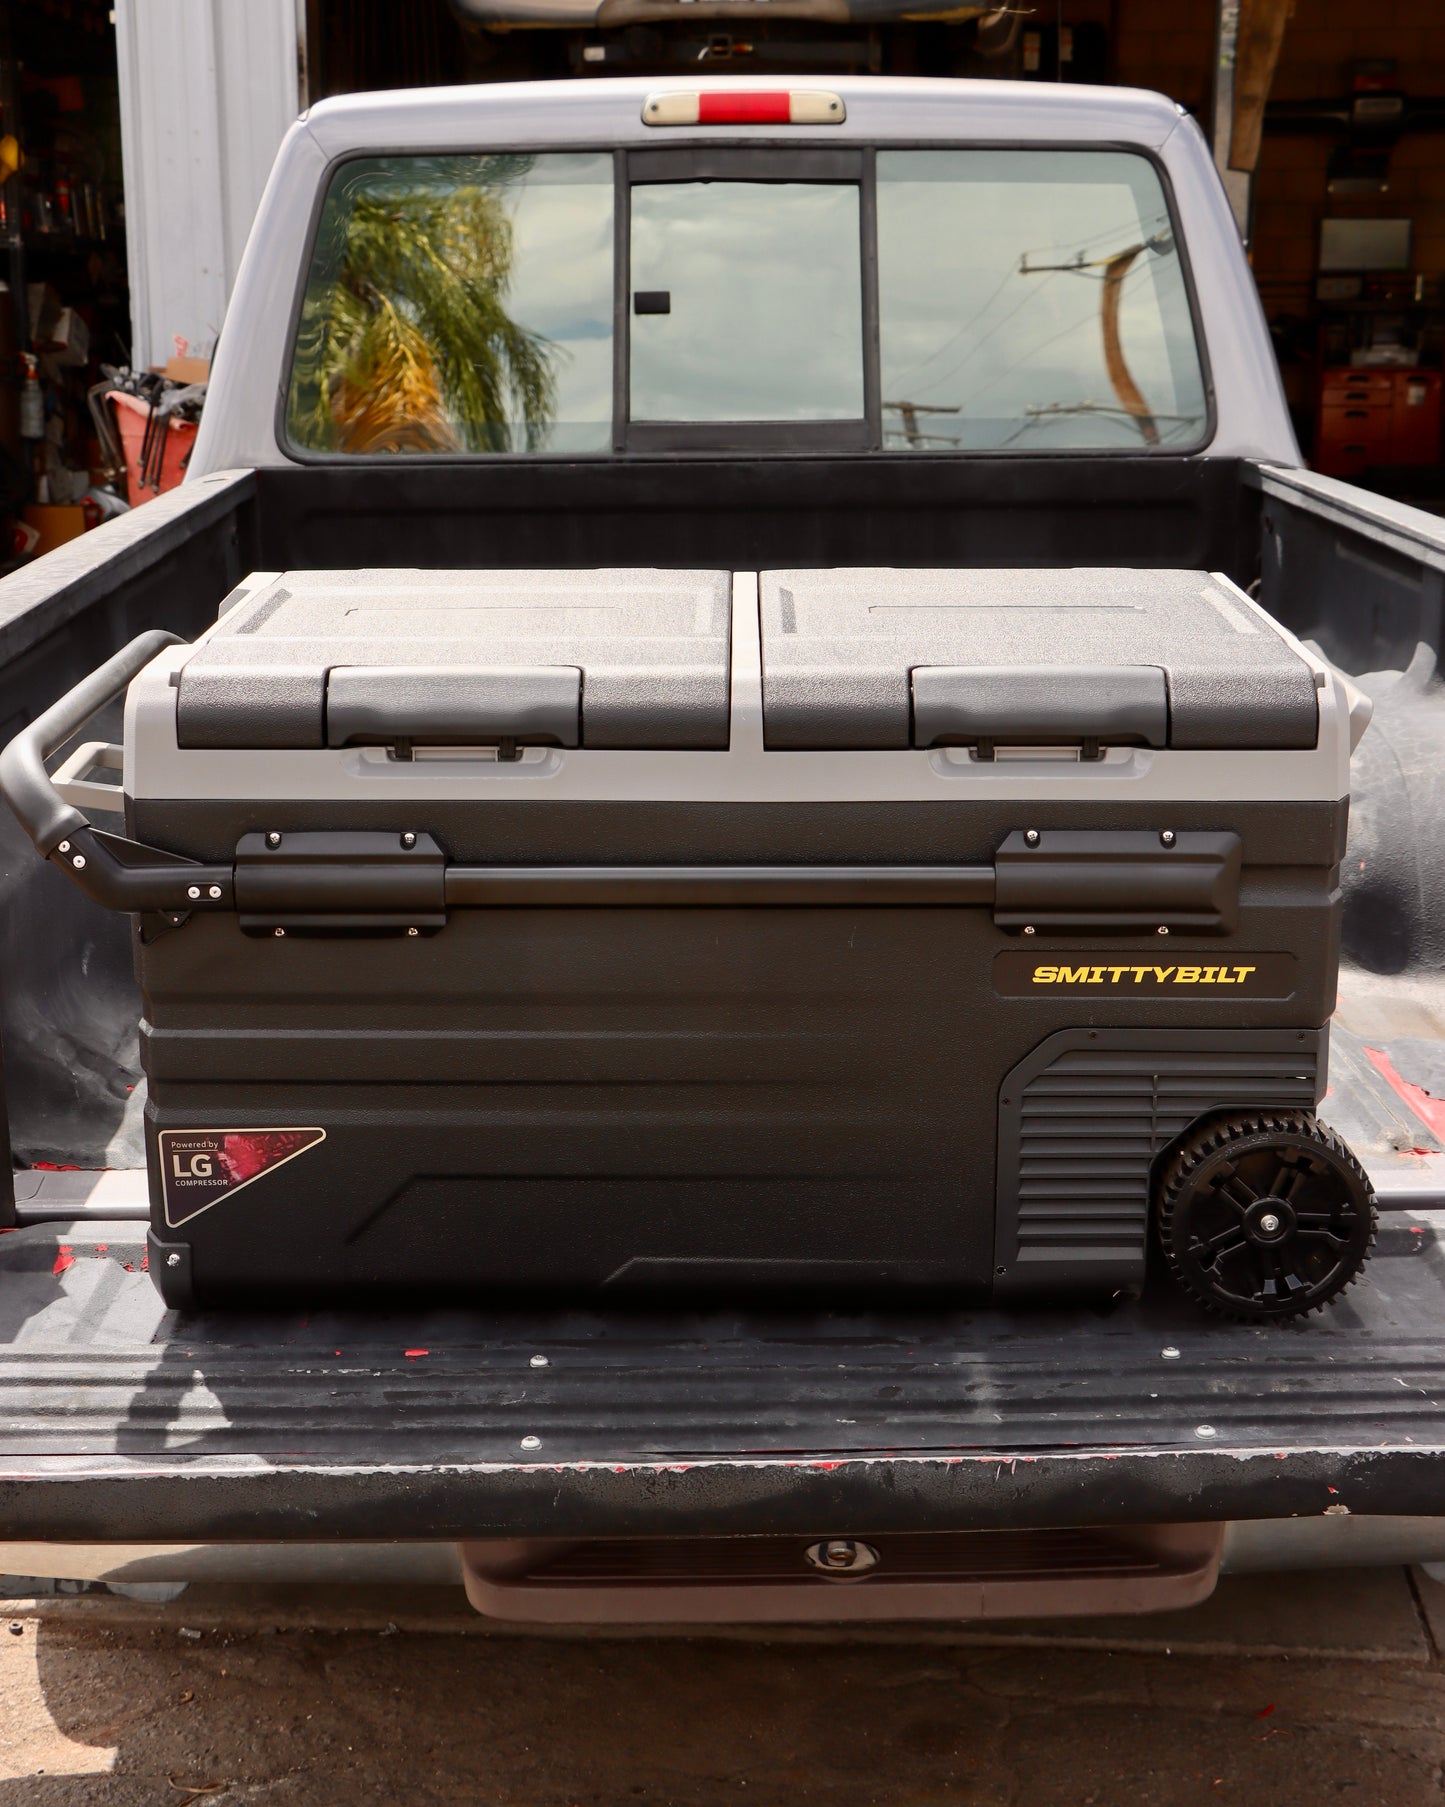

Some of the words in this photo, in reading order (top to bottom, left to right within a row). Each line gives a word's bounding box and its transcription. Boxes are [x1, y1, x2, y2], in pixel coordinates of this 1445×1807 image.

[1032, 966, 1256, 983] SMITTYBILT
[208, 1141, 219, 1149] by
[173, 1154, 213, 1177] LG
